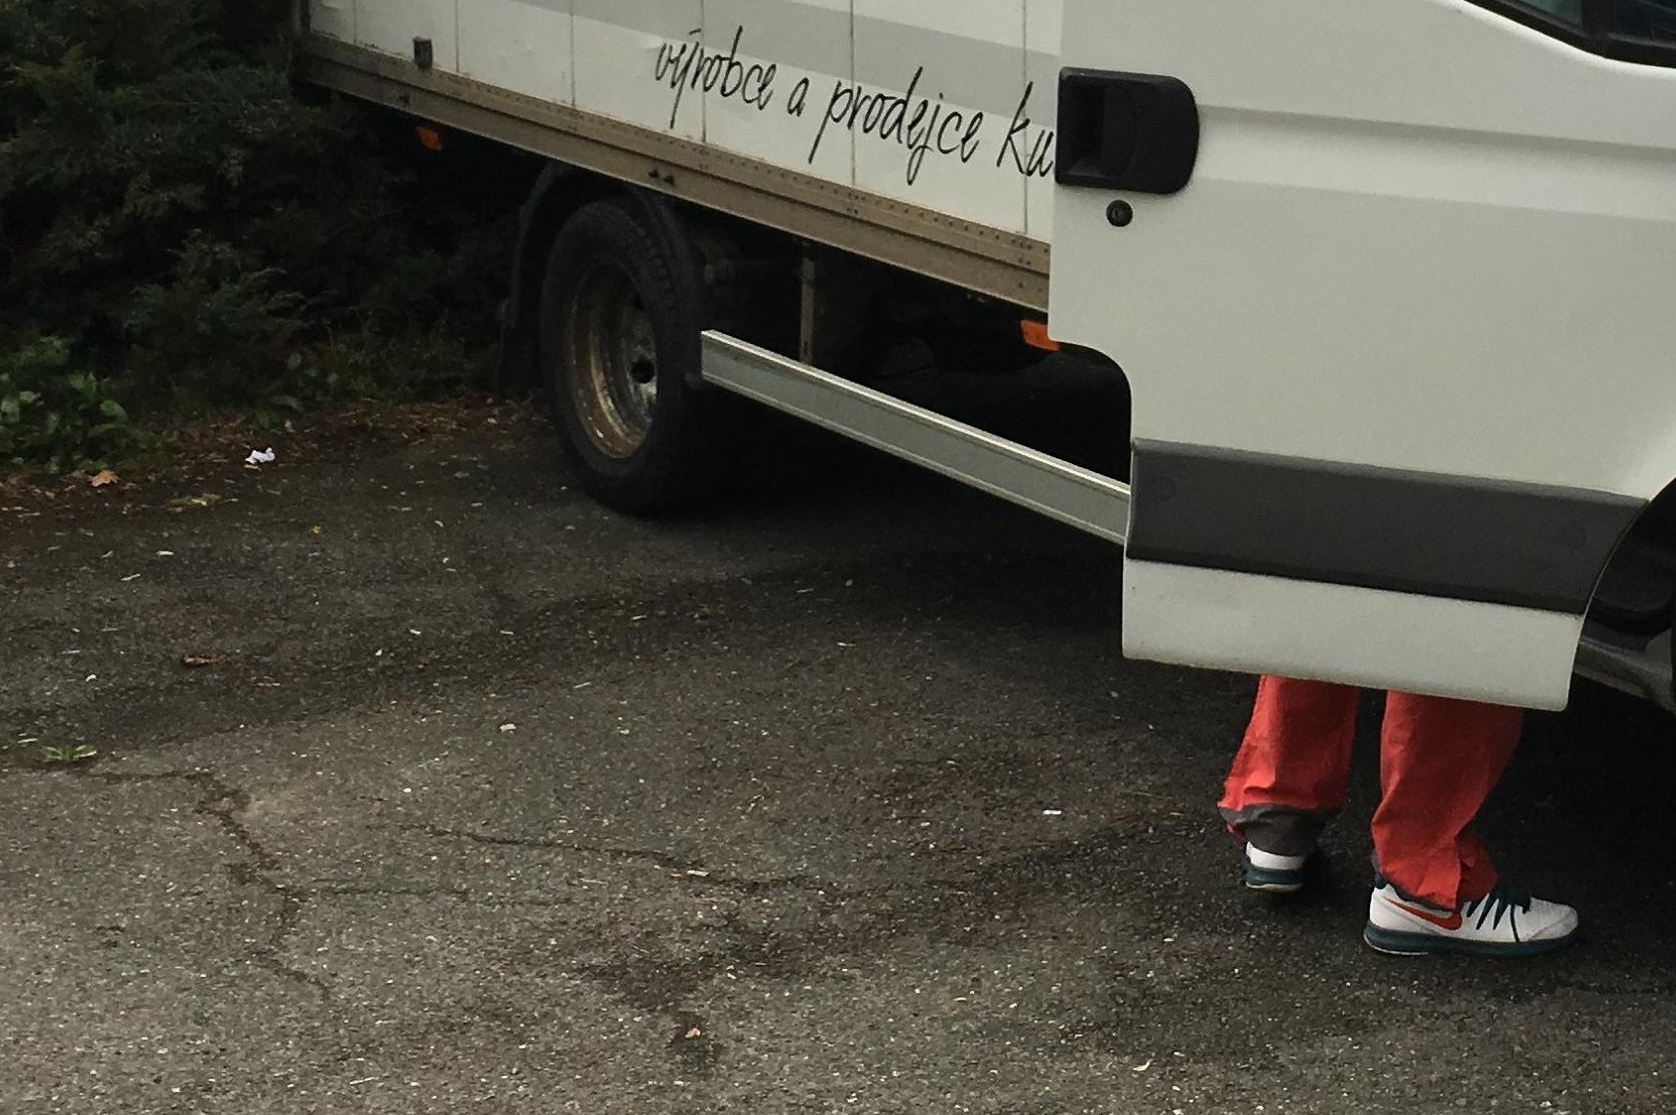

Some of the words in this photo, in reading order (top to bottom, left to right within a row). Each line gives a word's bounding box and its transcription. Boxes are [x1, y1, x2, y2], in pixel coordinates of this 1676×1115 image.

[654, 25, 778, 130] výrobce
[786, 76, 810, 118] a
[808, 66, 985, 186] prodejce
